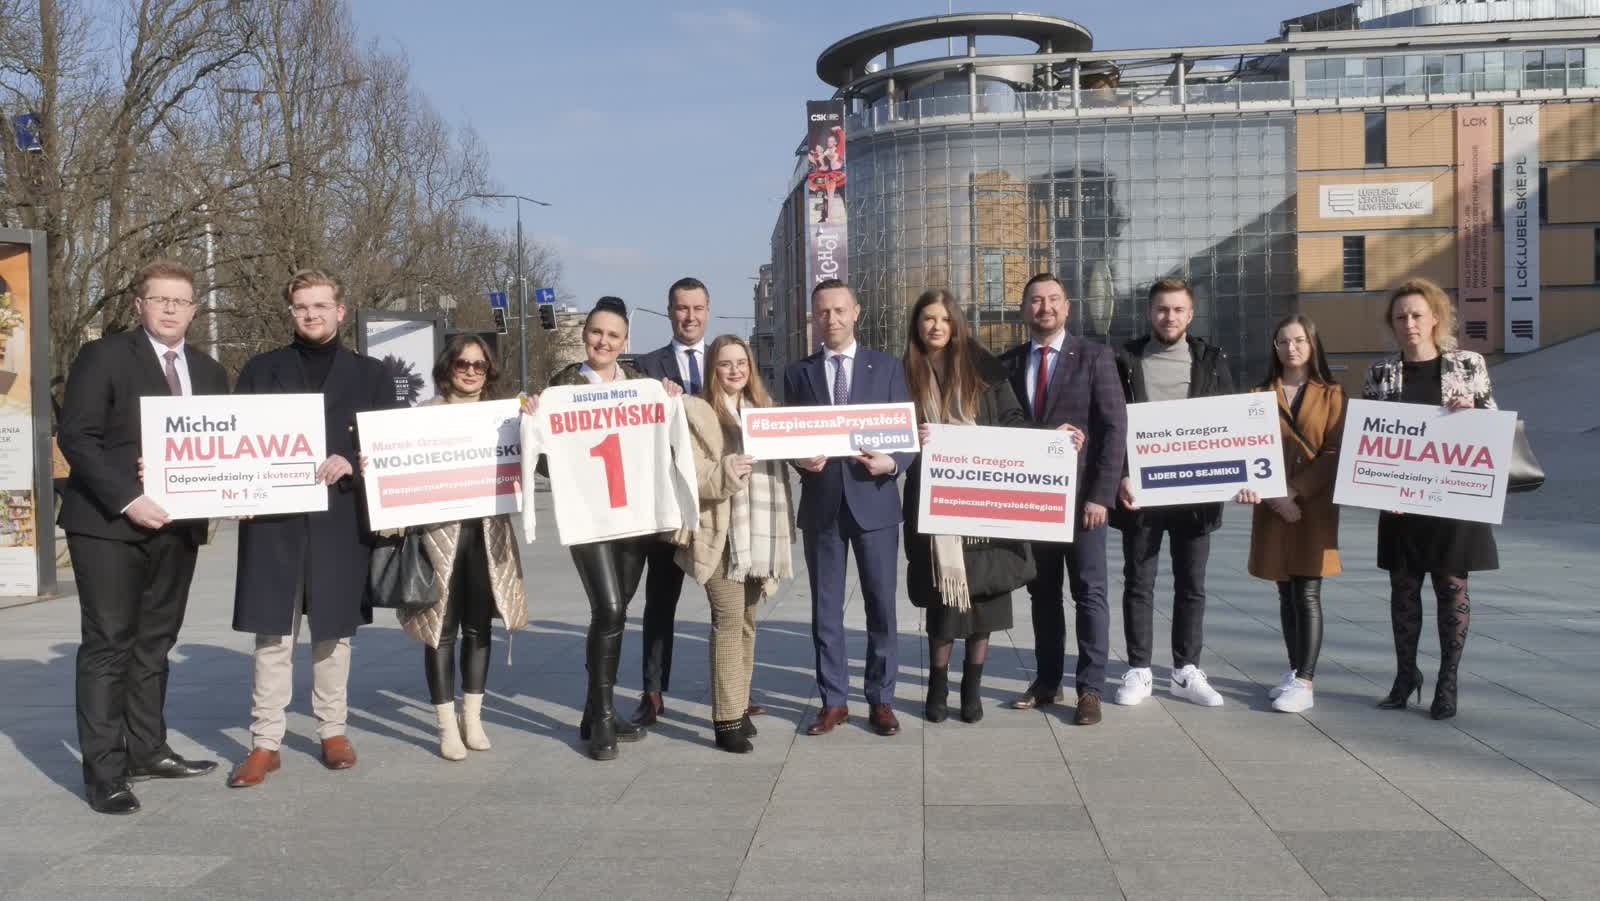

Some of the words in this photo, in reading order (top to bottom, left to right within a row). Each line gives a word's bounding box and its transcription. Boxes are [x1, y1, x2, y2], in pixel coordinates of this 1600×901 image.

[810, 113, 827, 121] CSK
[1463, 116, 1488, 127] LCK
[1508, 115, 1534, 127] LCK
[1516, 156, 1529, 288] LCK.LUBELSKIE.PL
[572, 391, 608, 403] Justyna
[610, 389, 638, 400] Marta
[165, 415, 237, 433] Michał
[550, 402, 666, 434] BUDZYŃSKA
[752, 412, 908, 433] #BezpiecznaPrzyszłość
[1363, 417, 1426, 437] Michał
[854, 433, 909, 449] Regionu
[1136, 429, 1172, 440] Marek
[1175, 425, 1229, 437] Grzegorz
[165, 433, 314, 462] MULAWA
[1047, 445, 1065, 455] PiS
[1136, 434, 1275, 455] WOJCIECHOWSKI
[1358, 435, 1494, 470] MULAWA
[373, 444, 521, 469] WOJCIECHOWSKI
[931, 453, 968, 464] Marek
[972, 456, 1025, 469] Grzegorz
[590, 433, 628, 508] 1
[930, 468, 1069, 487] WOJCIECHOWSKI
[1148, 471, 1177, 481] LIDER
[1179, 470, 1193, 479] DO
[1195, 467, 1240, 478] SEJMIKU
[1253, 458, 1273, 479] 3
[169, 472, 254, 485] Odpowiedzialny
[263, 471, 311, 483] skuteczny
[1357, 467, 1433, 486] Odpowiedzialny
[1440, 477, 1489, 493] skuteczny
[222, 490, 239, 500] Nr
[1400, 488, 1416, 498] Nr
